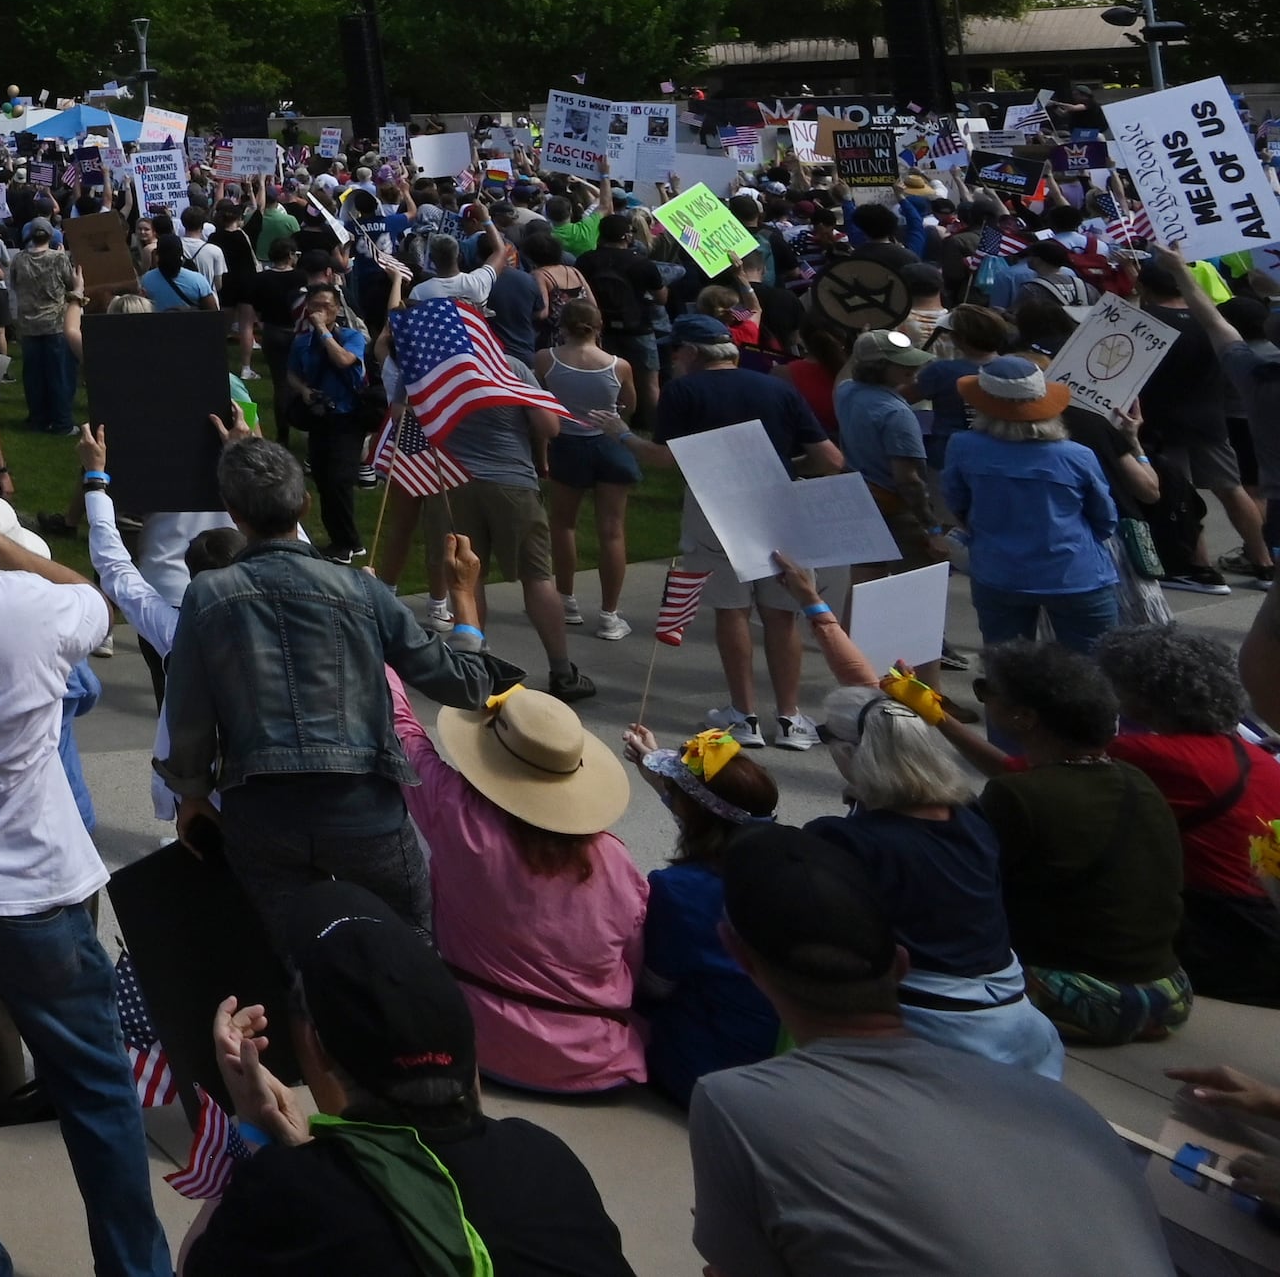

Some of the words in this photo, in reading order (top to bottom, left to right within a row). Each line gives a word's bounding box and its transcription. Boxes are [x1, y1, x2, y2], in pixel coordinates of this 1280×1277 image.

[553, 94, 574, 106] THIS
[578, 99, 586, 108] IS
[589, 102, 610, 113] WHAT
[630, 106, 642, 115] HIS
[872, 116, 893, 124] KEEP
[1190, 100, 1225, 139] US
[135, 154, 173, 165] KIDNAPPING
[738, 155, 756, 163] 1776
[875, 148, 890, 159] IN
[546, 153, 571, 166] LOOKS
[576, 160, 594, 172] LIKE
[840, 159, 894, 174] SILENCE
[1068, 158, 1088, 166] NO
[1209, 150, 1245, 184] OF
[134, 163, 178, 175] EMOLUMENTS
[142, 173, 177, 184] PATRONAGE
[1007, 176, 1027, 186] RUN
[1162, 130, 1222, 226] MEANS
[166, 182, 182, 190] DOGE
[145, 191, 164, 202] ABUSE
[668, 209, 694, 231] NO
[685, 193, 719, 222] KINGS
[1229, 192, 1271, 240] ALL
[698, 219, 747, 265] AMERICA
[1100, 303, 1121, 323] No
[1131, 322, 1167, 352] Kings
[1056, 371, 1113, 410] America
